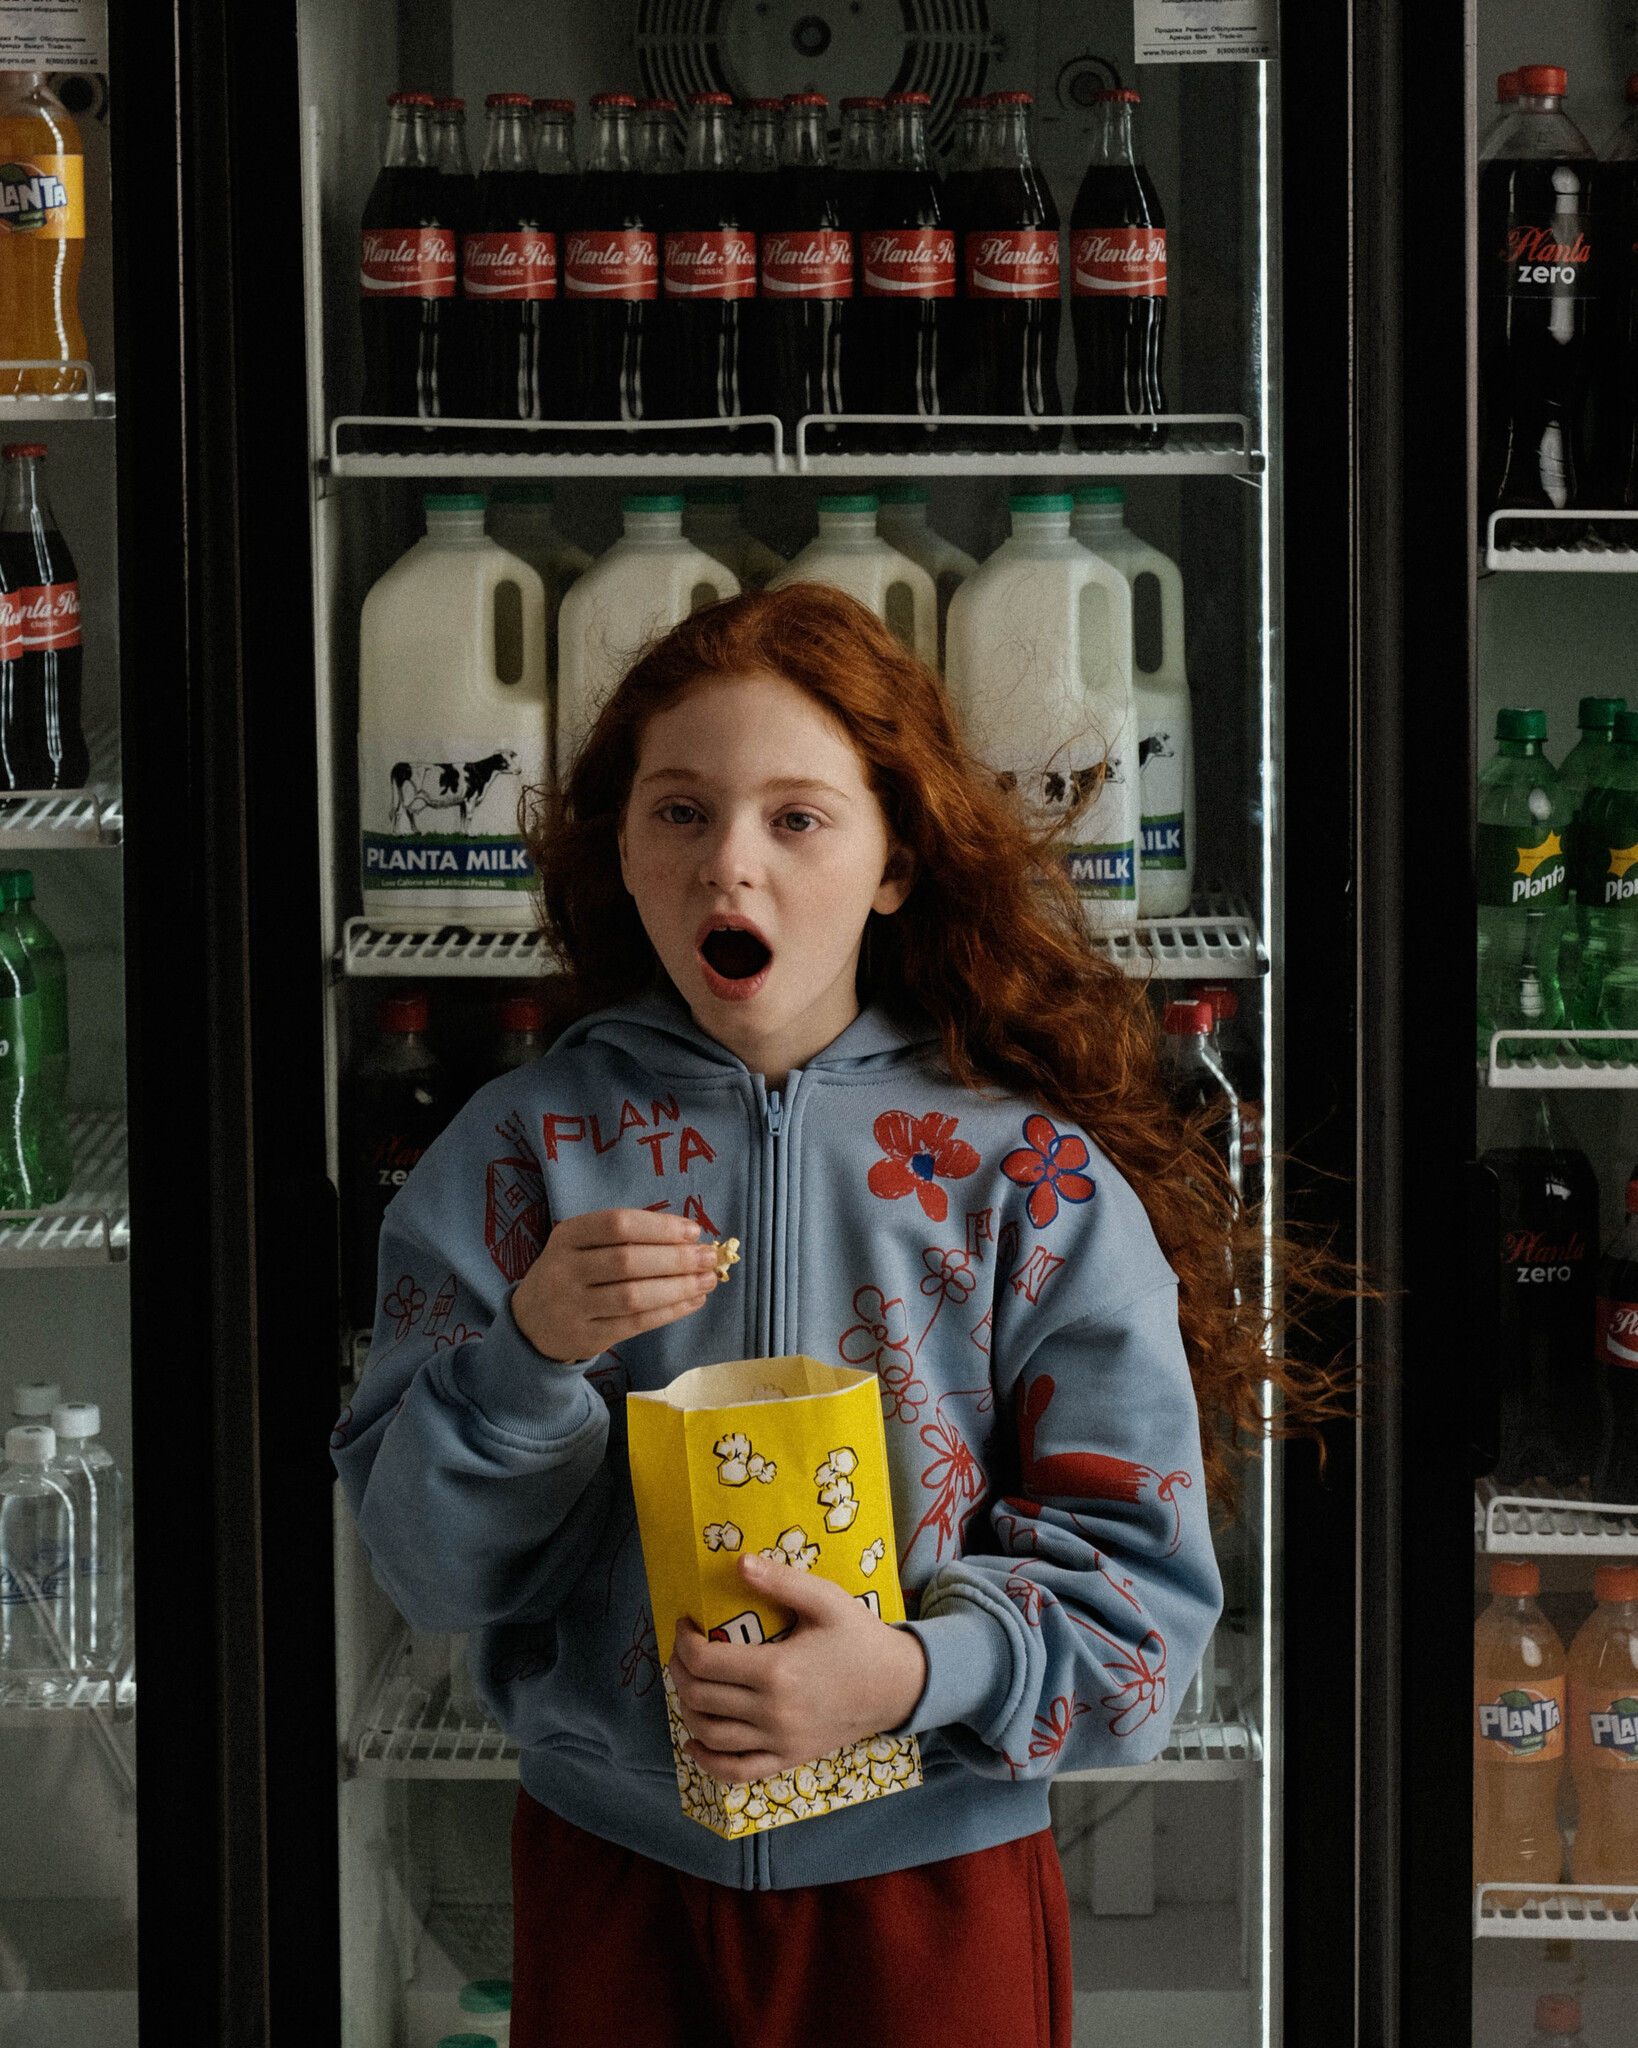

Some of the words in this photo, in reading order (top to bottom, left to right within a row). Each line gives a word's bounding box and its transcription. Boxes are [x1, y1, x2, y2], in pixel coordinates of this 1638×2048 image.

[1143, 48, 1208, 56] www.frost-pro.com
[764, 238, 823, 265] Planta
[867, 237, 932, 264] Planta
[976, 238, 1042, 266] Planta
[1076, 236, 1144, 263] Planta
[1498, 225, 1592, 263] Planta
[1517, 265, 1576, 284] zero
[366, 847, 459, 871] PLANTA
[466, 848, 528, 871] MILK
[1070, 857, 1131, 880] MILK
[542, 1092, 680, 1163] PLAN
[636, 1126, 717, 1176] TA
[1500, 1229, 1586, 1264] Planta
[1517, 1265, 1571, 1283] zero
[1478, 1699, 1561, 1737] PLANTA
